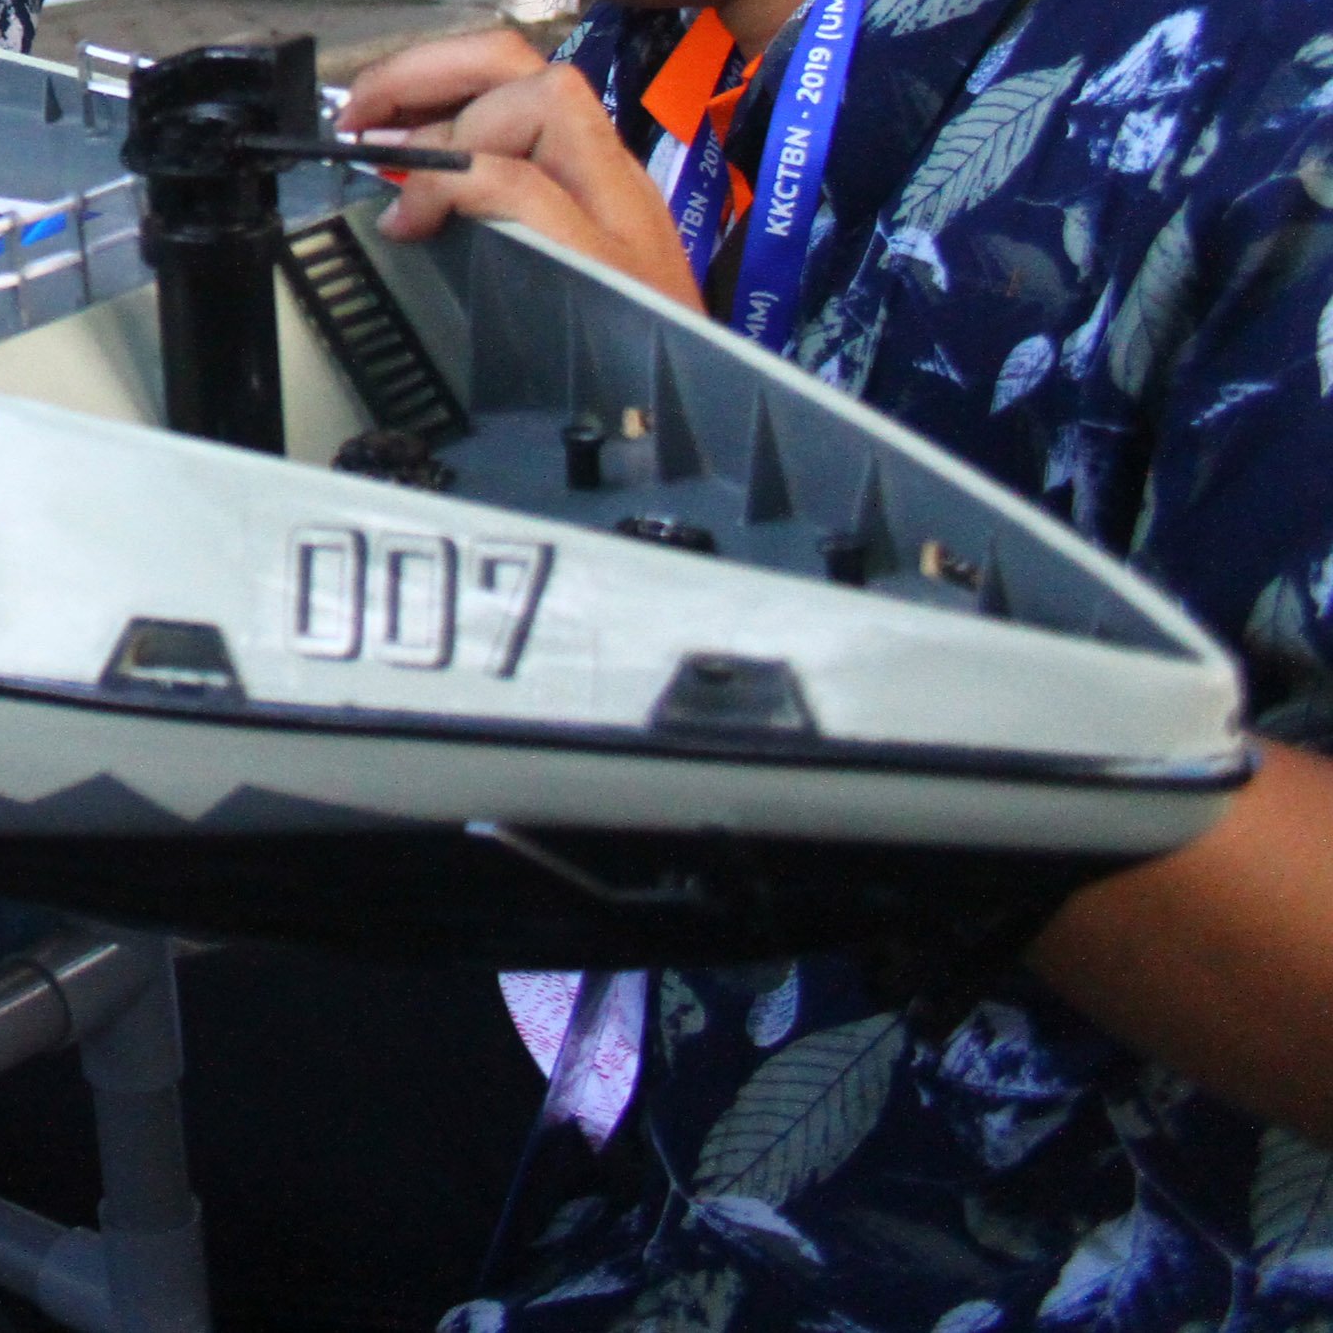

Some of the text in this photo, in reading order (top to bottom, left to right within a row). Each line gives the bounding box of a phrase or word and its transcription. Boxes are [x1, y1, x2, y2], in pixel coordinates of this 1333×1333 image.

[764, 125, 812, 238] KKCTBN
[795, 46, 832, 104] 2019
[289, 524, 555, 681] 007
